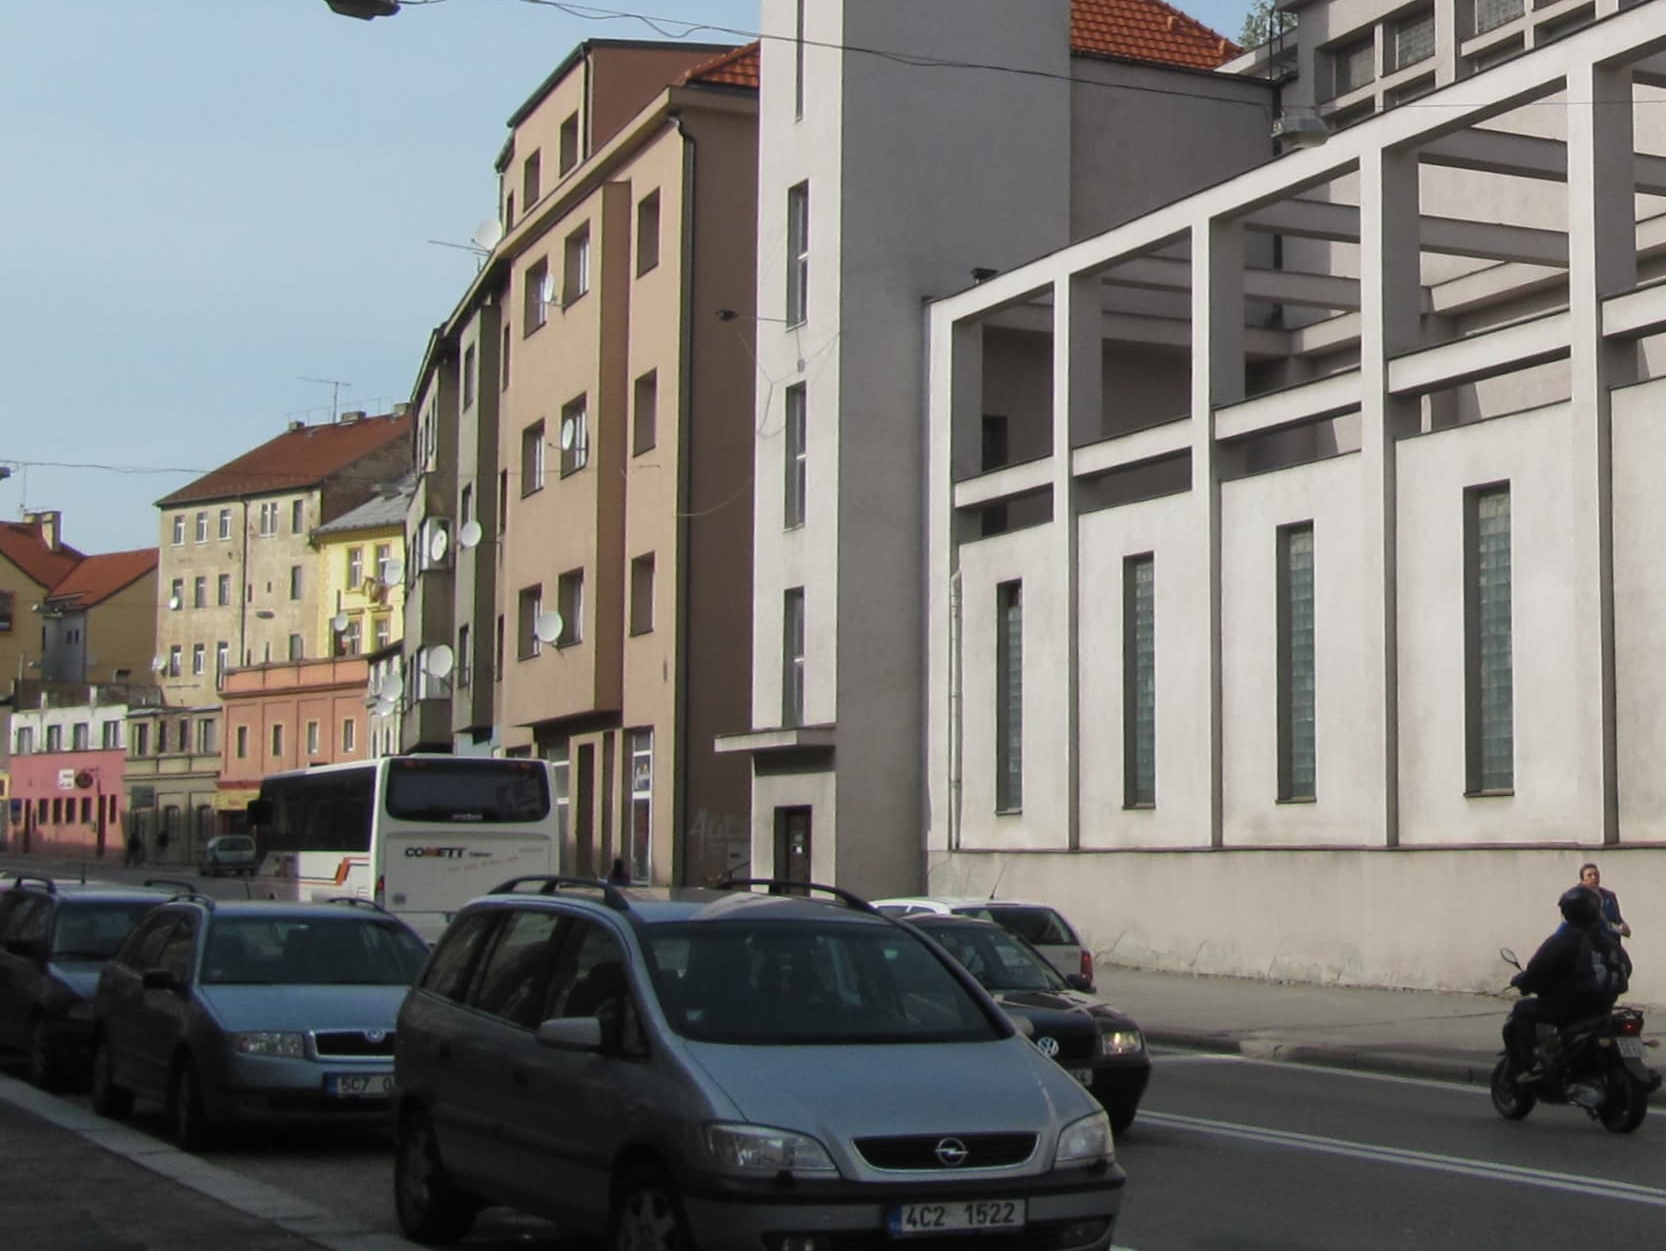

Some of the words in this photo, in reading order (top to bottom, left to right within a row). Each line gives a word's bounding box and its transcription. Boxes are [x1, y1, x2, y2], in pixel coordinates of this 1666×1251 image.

[340, 1076, 370, 1092] 5C7
[906, 1206, 945, 1228] 4C2
[964, 1202, 1015, 1225] 1522
